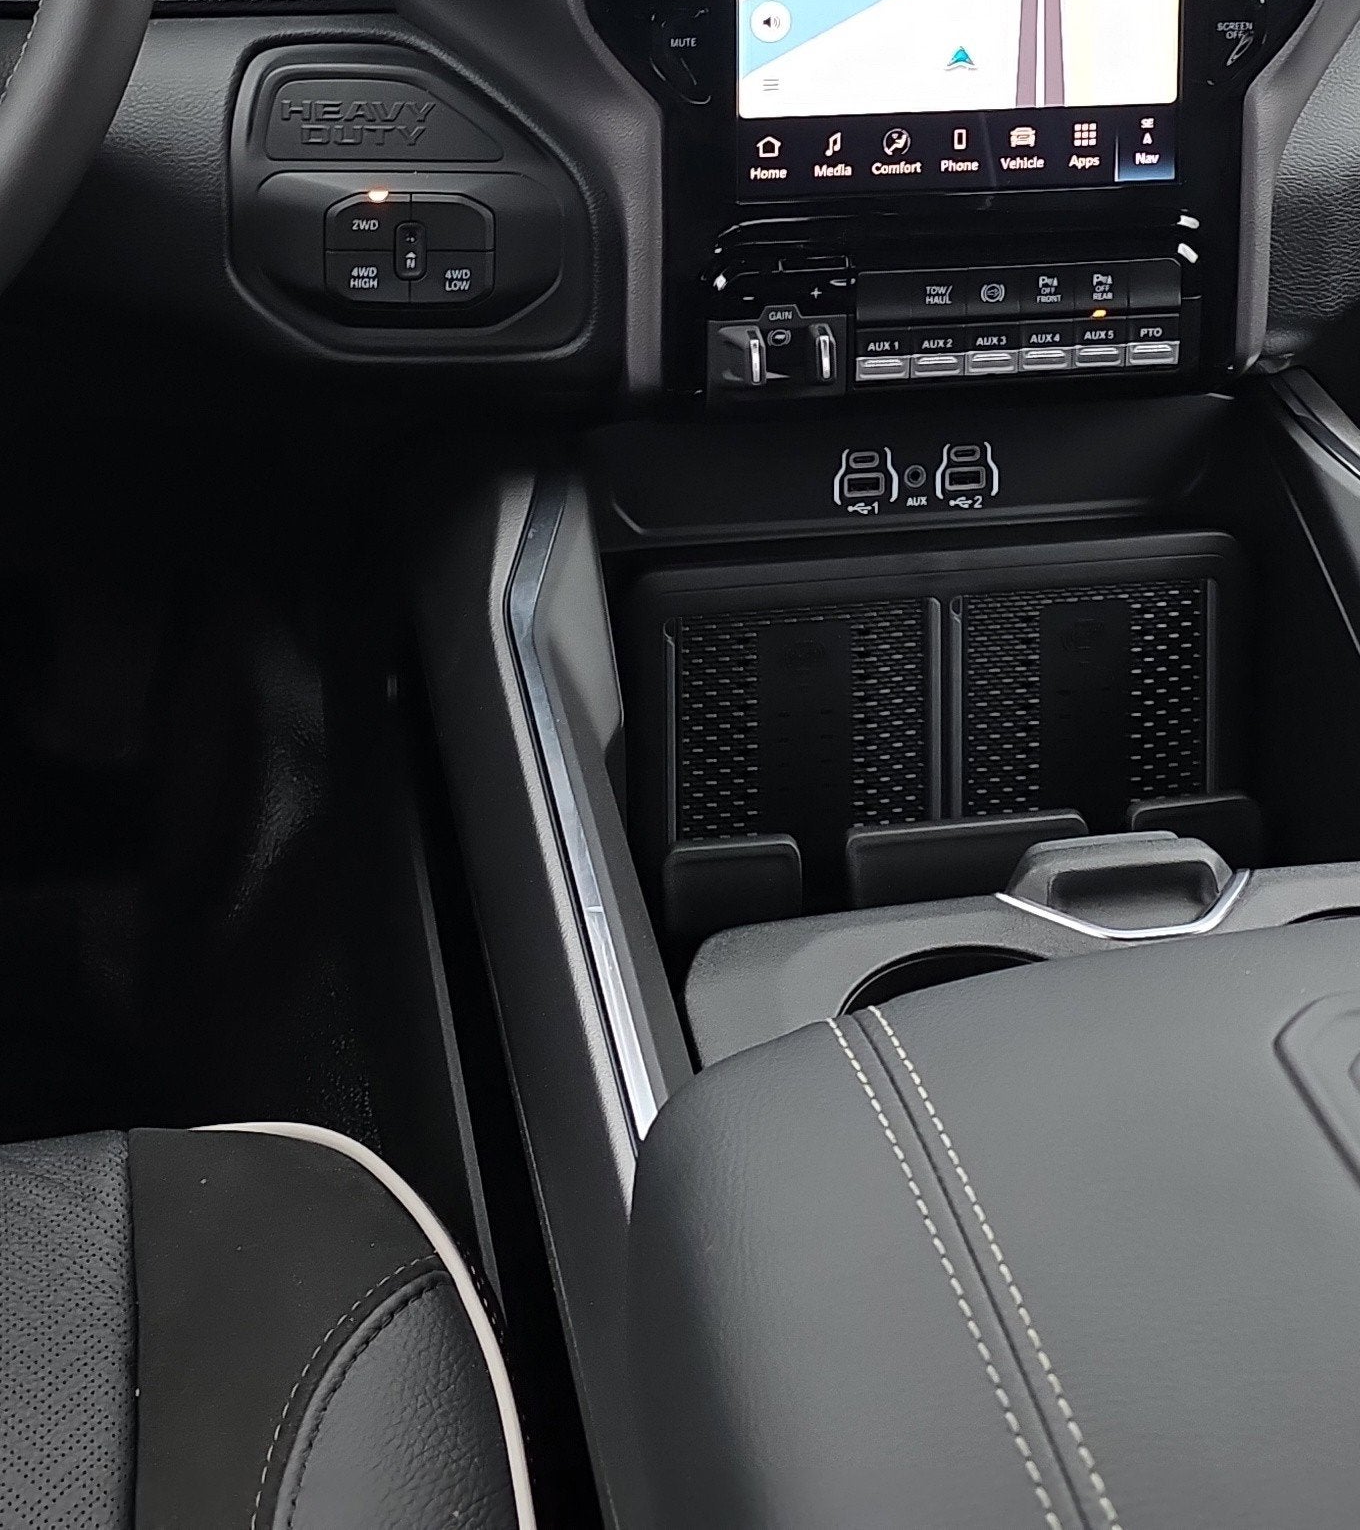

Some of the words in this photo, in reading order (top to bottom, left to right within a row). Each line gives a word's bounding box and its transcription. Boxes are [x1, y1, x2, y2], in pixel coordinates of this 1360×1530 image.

[1216, 22, 1253, 32] SCREEN
[670, 37, 697, 48] MUTE
[280, 99, 437, 122] HEAVY
[300, 123, 426, 146] DUTY
[1000, 156, 1045, 170] Vehicle
[1068, 155, 1100, 169] Apps
[1135, 153, 1160, 165] Nav
[813, 164, 852, 177] Media
[871, 161, 922, 175] Comfort
[940, 159, 979, 172] Phone
[750, 167, 788, 180] Home
[352, 220, 379, 231] 2WD
[406, 258, 416, 269] N
[351, 267, 378, 278] 4WD
[444, 269, 471, 280] 4WD
[350, 277, 378, 289] HIGH
[444, 280, 470, 292] LOW
[925, 285, 953, 297] TOW/
[1095, 285, 1110, 293] OFF
[925, 295, 952, 305] HAUL
[768, 311, 793, 321] GAIN
[1030, 334, 1052, 344] AUX
[1052, 333, 1060, 342] 4
[1084, 332, 1106, 340] AUX
[1106, 330, 1114, 339] 5
[1140, 328, 1163, 338] PTO
[867, 342, 890, 351] AUX
[893, 341, 899, 350] 1
[922, 340, 945, 349] AUX
[946, 338, 953, 348] 2
[976, 337, 998, 346] AUX
[998, 336, 1007, 345] 3
[906, 496, 928, 507] AUX
[973, 495, 983, 509] 2
[872, 501, 879, 515] 1
